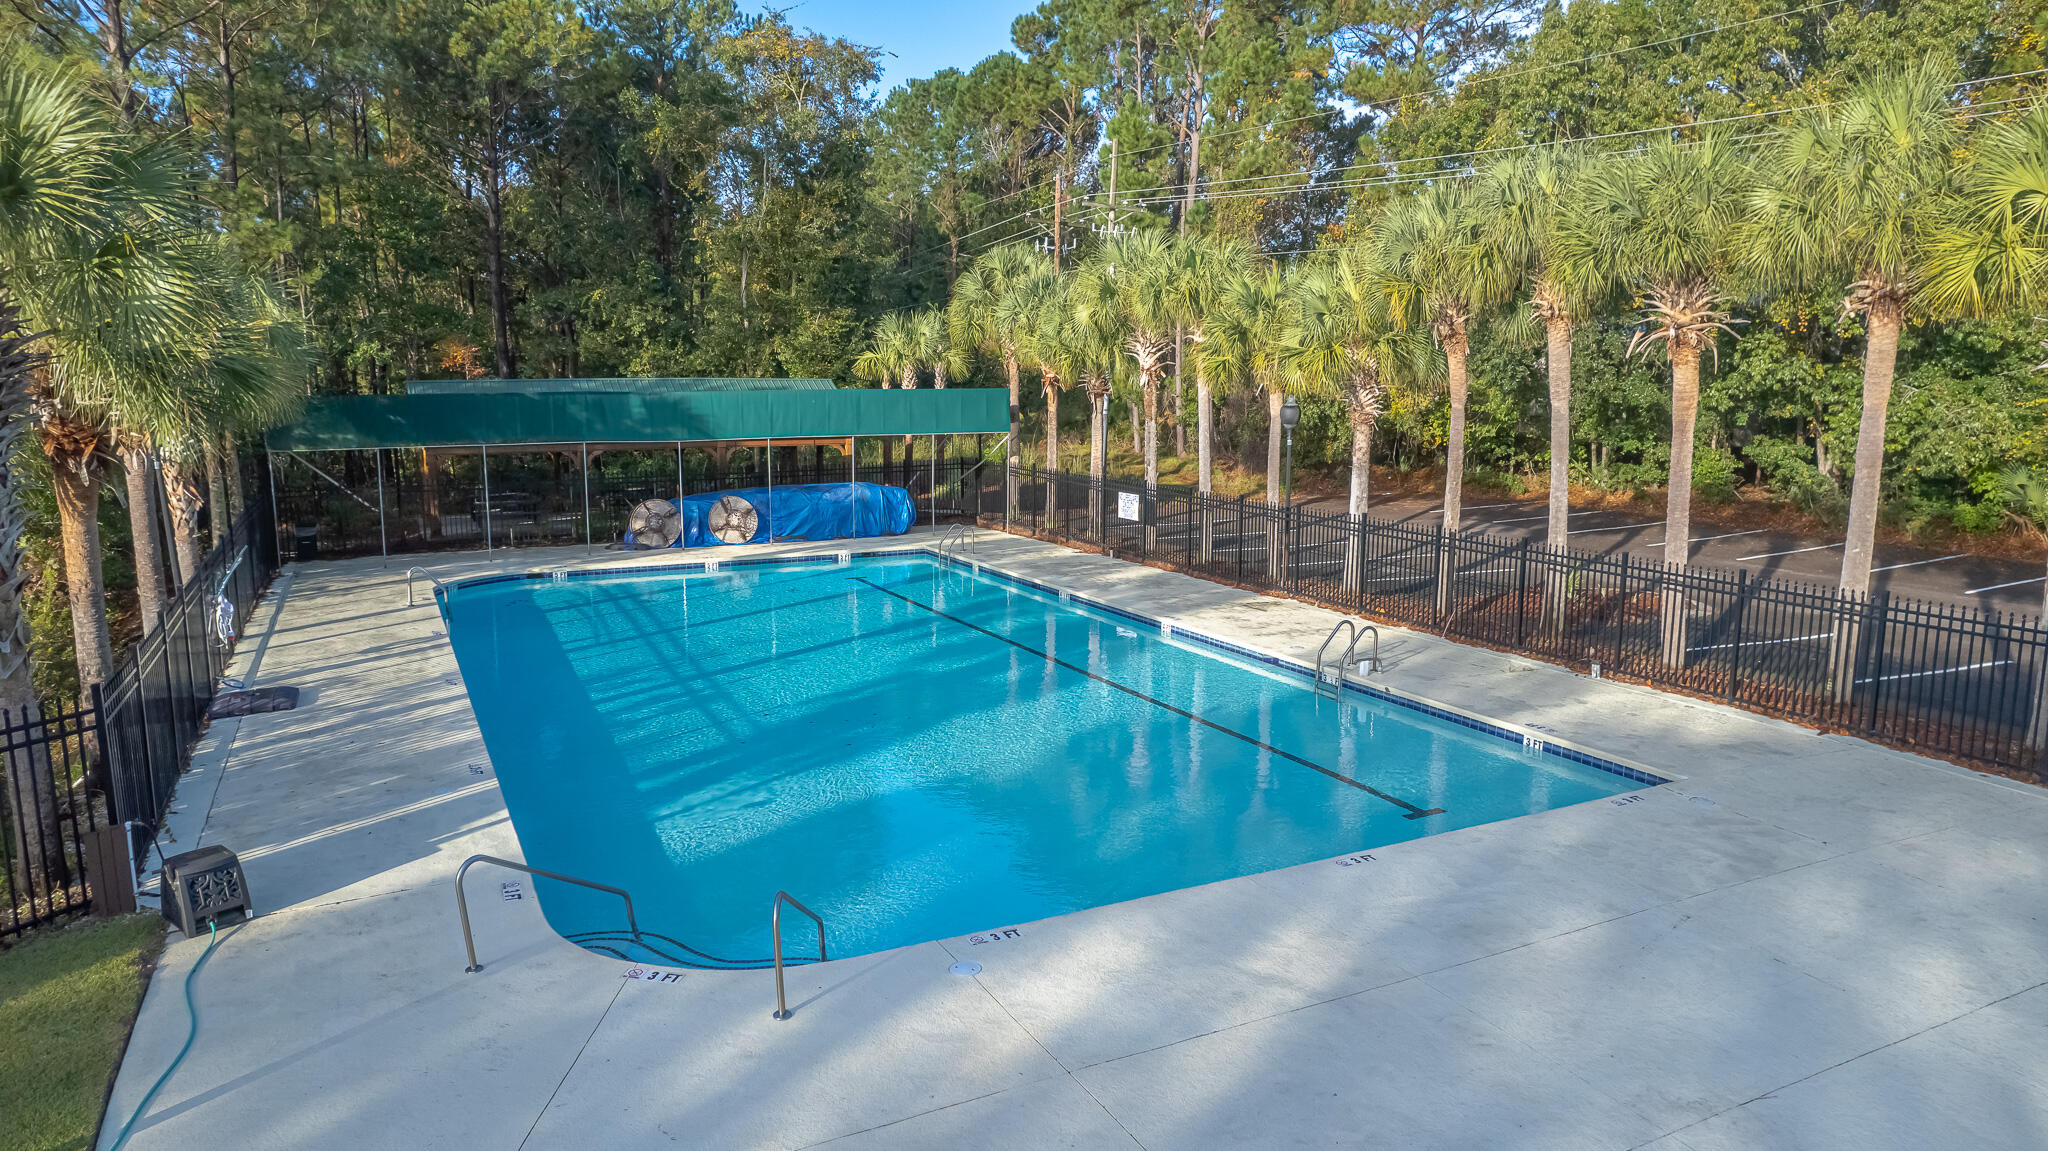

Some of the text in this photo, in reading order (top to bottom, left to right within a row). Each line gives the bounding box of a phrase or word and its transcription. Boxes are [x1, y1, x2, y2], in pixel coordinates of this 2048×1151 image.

[1525, 737, 1542, 750] 3 FT
[1360, 854, 1377, 862] FT
[990, 928, 1021, 941] 3 FT
[647, 971, 660, 981] 3
[660, 972, 683, 983] FT
